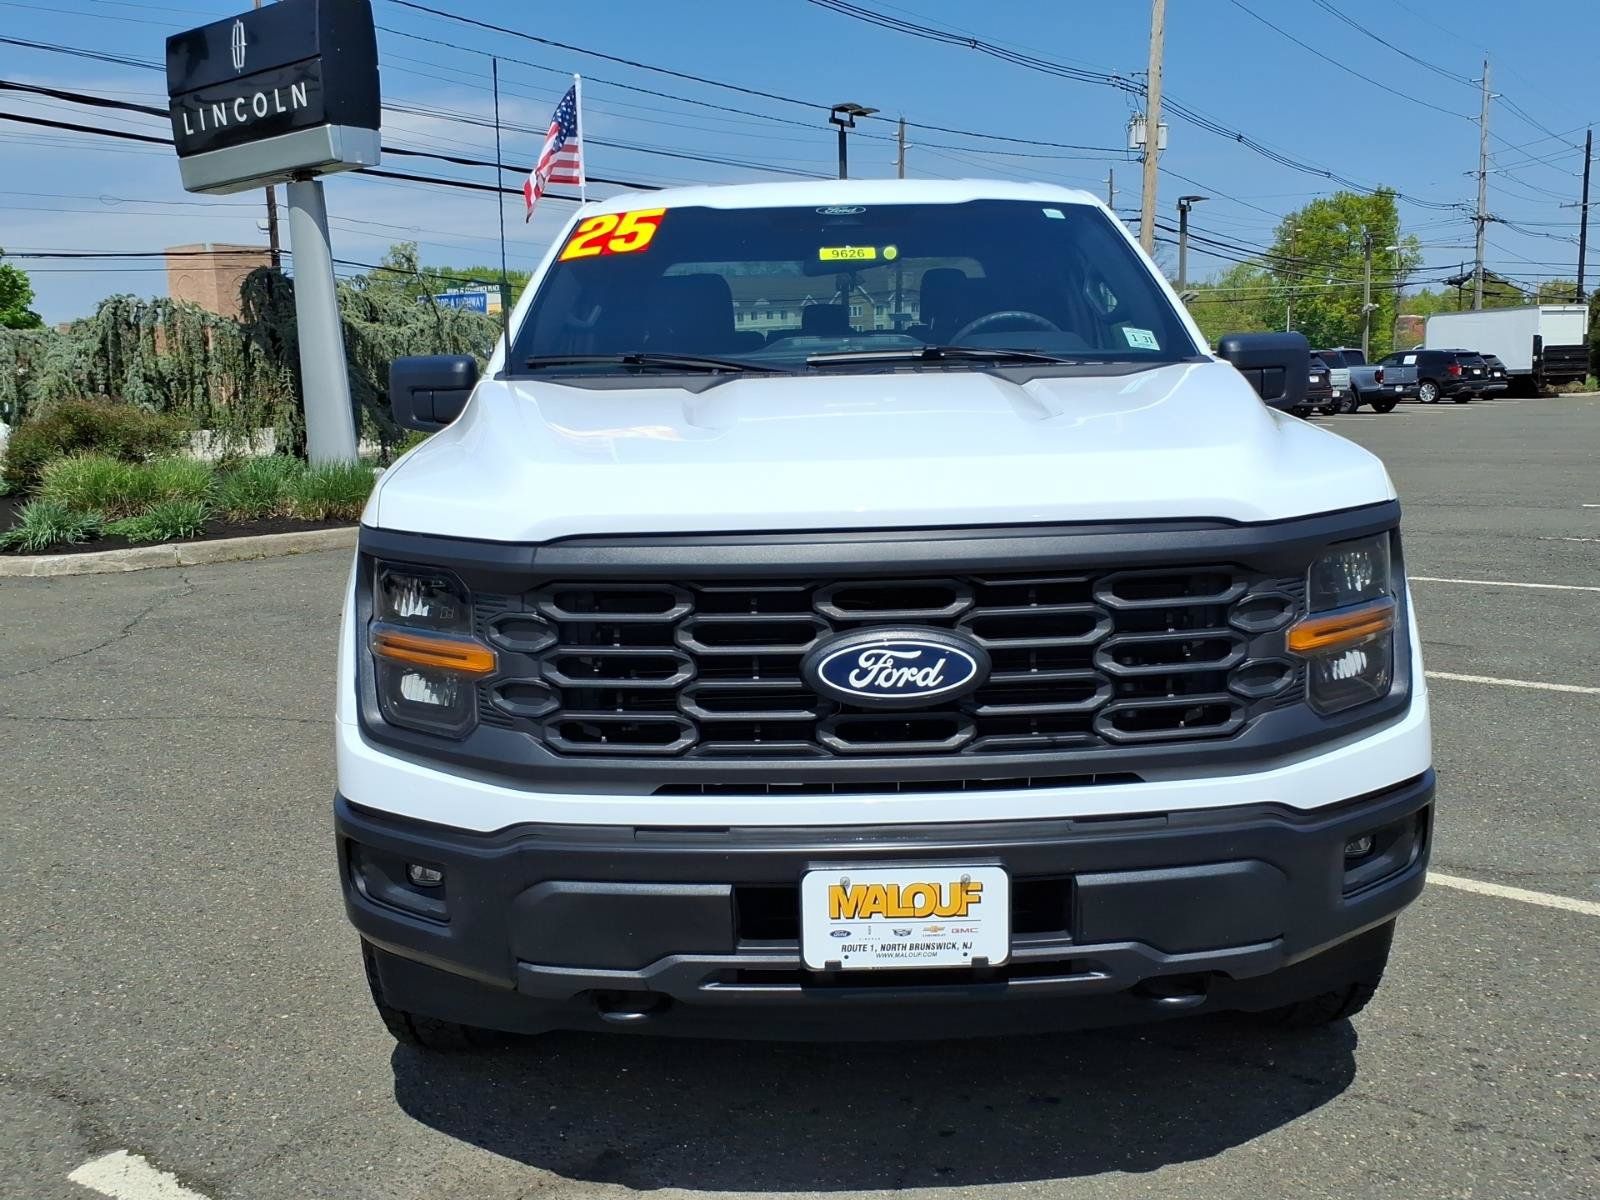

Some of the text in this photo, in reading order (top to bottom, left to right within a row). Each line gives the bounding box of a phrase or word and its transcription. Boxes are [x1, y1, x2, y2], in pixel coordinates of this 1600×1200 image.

[183, 82, 307, 135] LINCOLN
[824, 205, 858, 215] Ford
[559, 208, 667, 260] 25
[831, 249, 865, 258] 9626
[848, 649, 947, 688] Ford
[828, 881, 983, 919] MALOUF
[841, 944, 868, 952] ROUTE
[880, 943, 907, 951] NORTH
[962, 941, 973, 950] NJ
